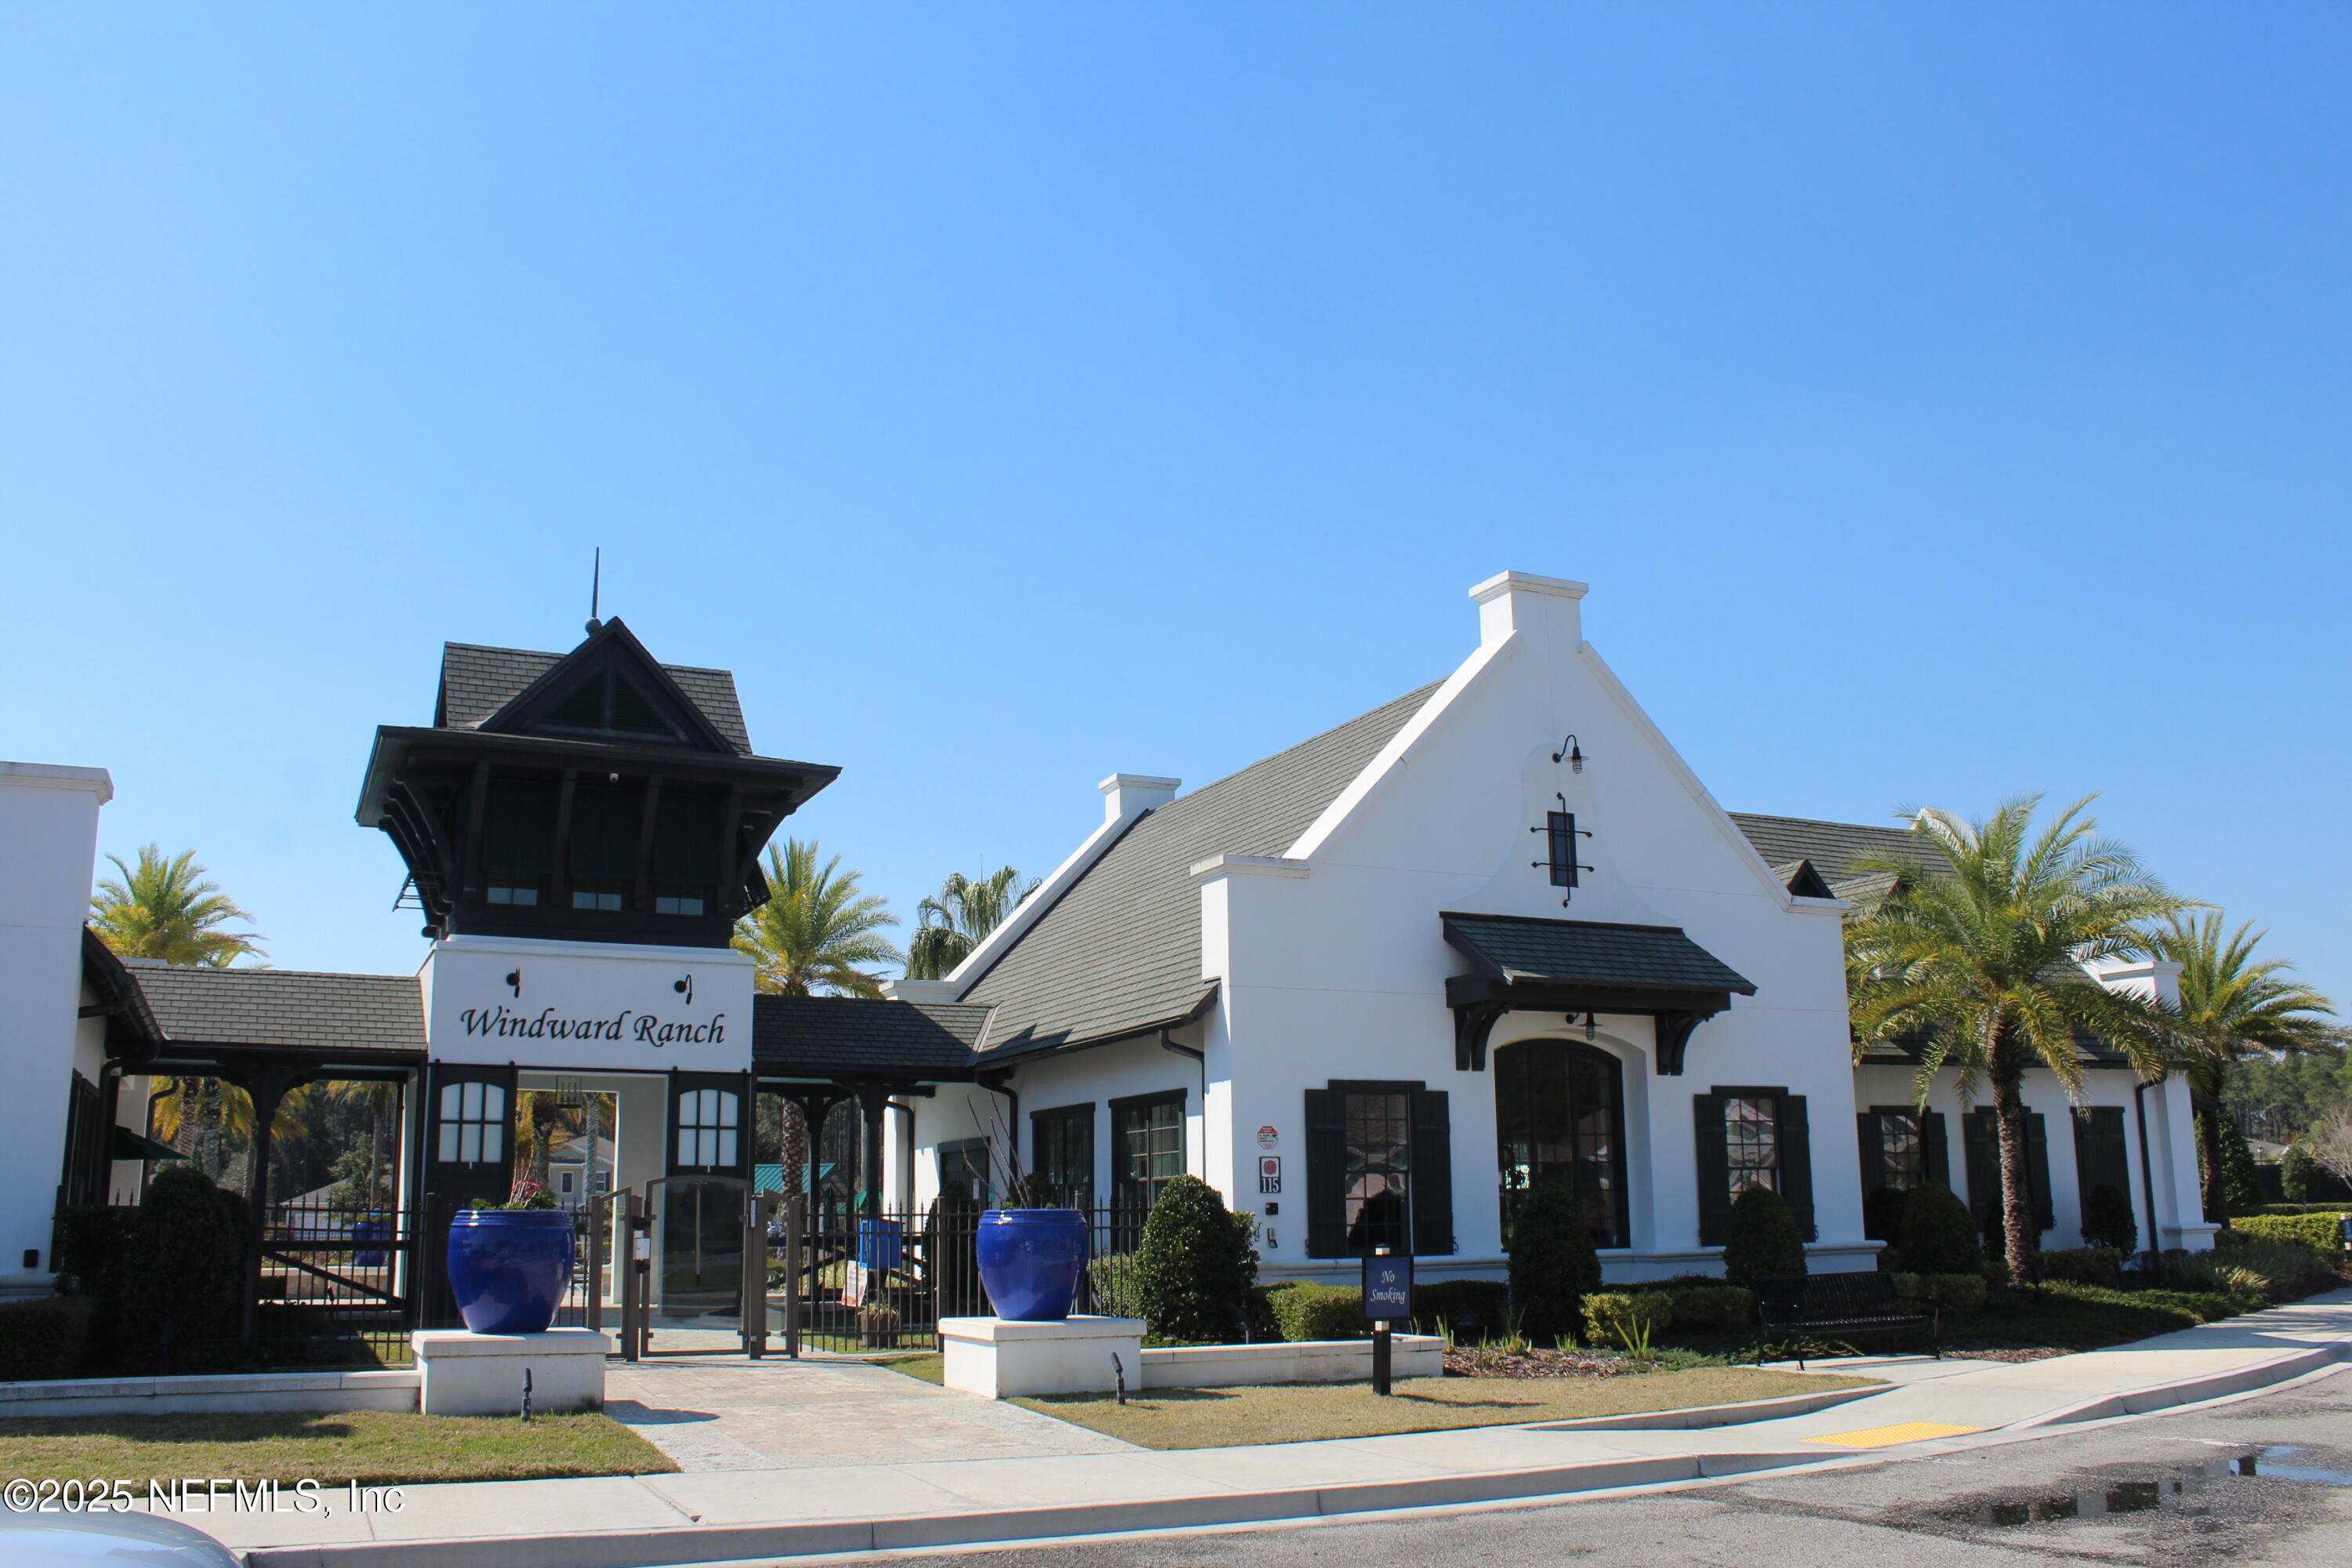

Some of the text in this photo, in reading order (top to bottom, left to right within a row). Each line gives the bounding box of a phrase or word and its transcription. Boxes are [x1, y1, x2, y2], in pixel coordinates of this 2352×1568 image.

[460, 1005, 725, 1047] Windward Ranch
[1262, 1178, 1279, 1192] 115
[1381, 1270, 1395, 1283] No
[1370, 1287, 1406, 1304] Smoking
